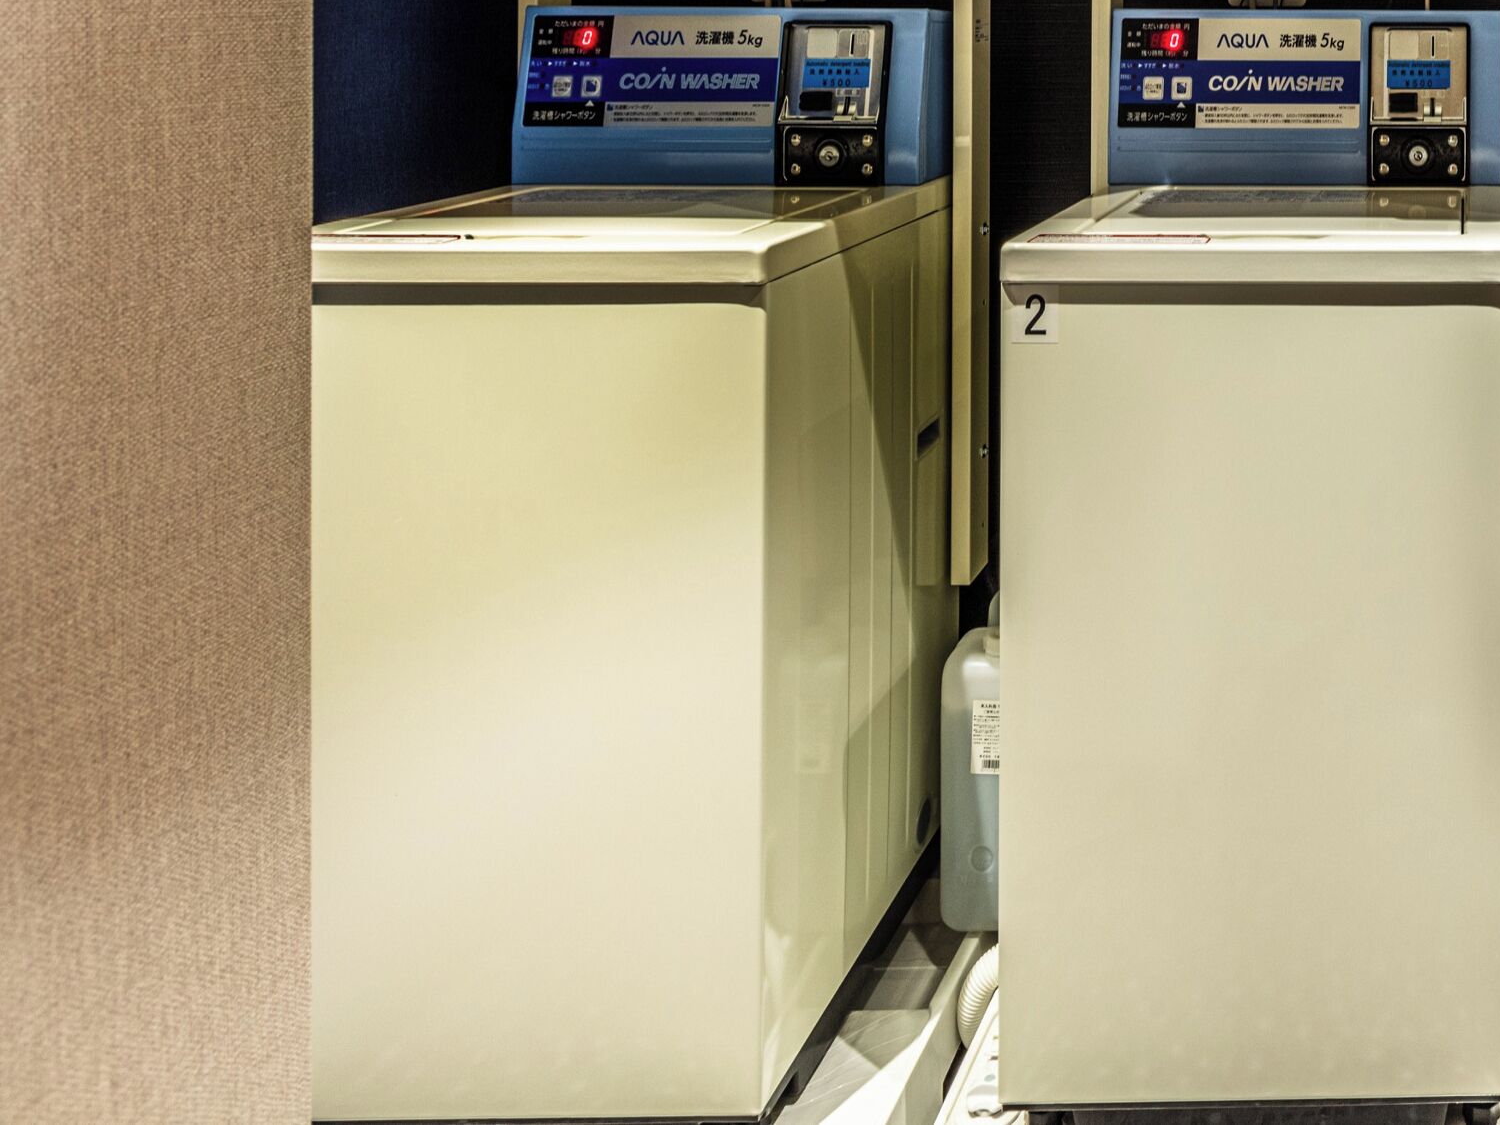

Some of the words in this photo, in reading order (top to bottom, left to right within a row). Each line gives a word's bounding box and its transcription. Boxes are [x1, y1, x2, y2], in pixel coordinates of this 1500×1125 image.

[582, 31, 592, 44] 0
[631, 30, 684, 46] AQUA
[696, 30, 734, 46] 洗濯機
[737, 29, 763, 48] 5kg
[1170, 34, 1179, 47] 0
[1217, 34, 1269, 49] AQUA
[1280, 34, 1317, 48] 洗濯機
[1320, 33, 1344, 51] 5kg
[681, 73, 760, 90] WASHER
[1267, 76, 1344, 92] WASHER
[1025, 294, 1046, 335] 2
